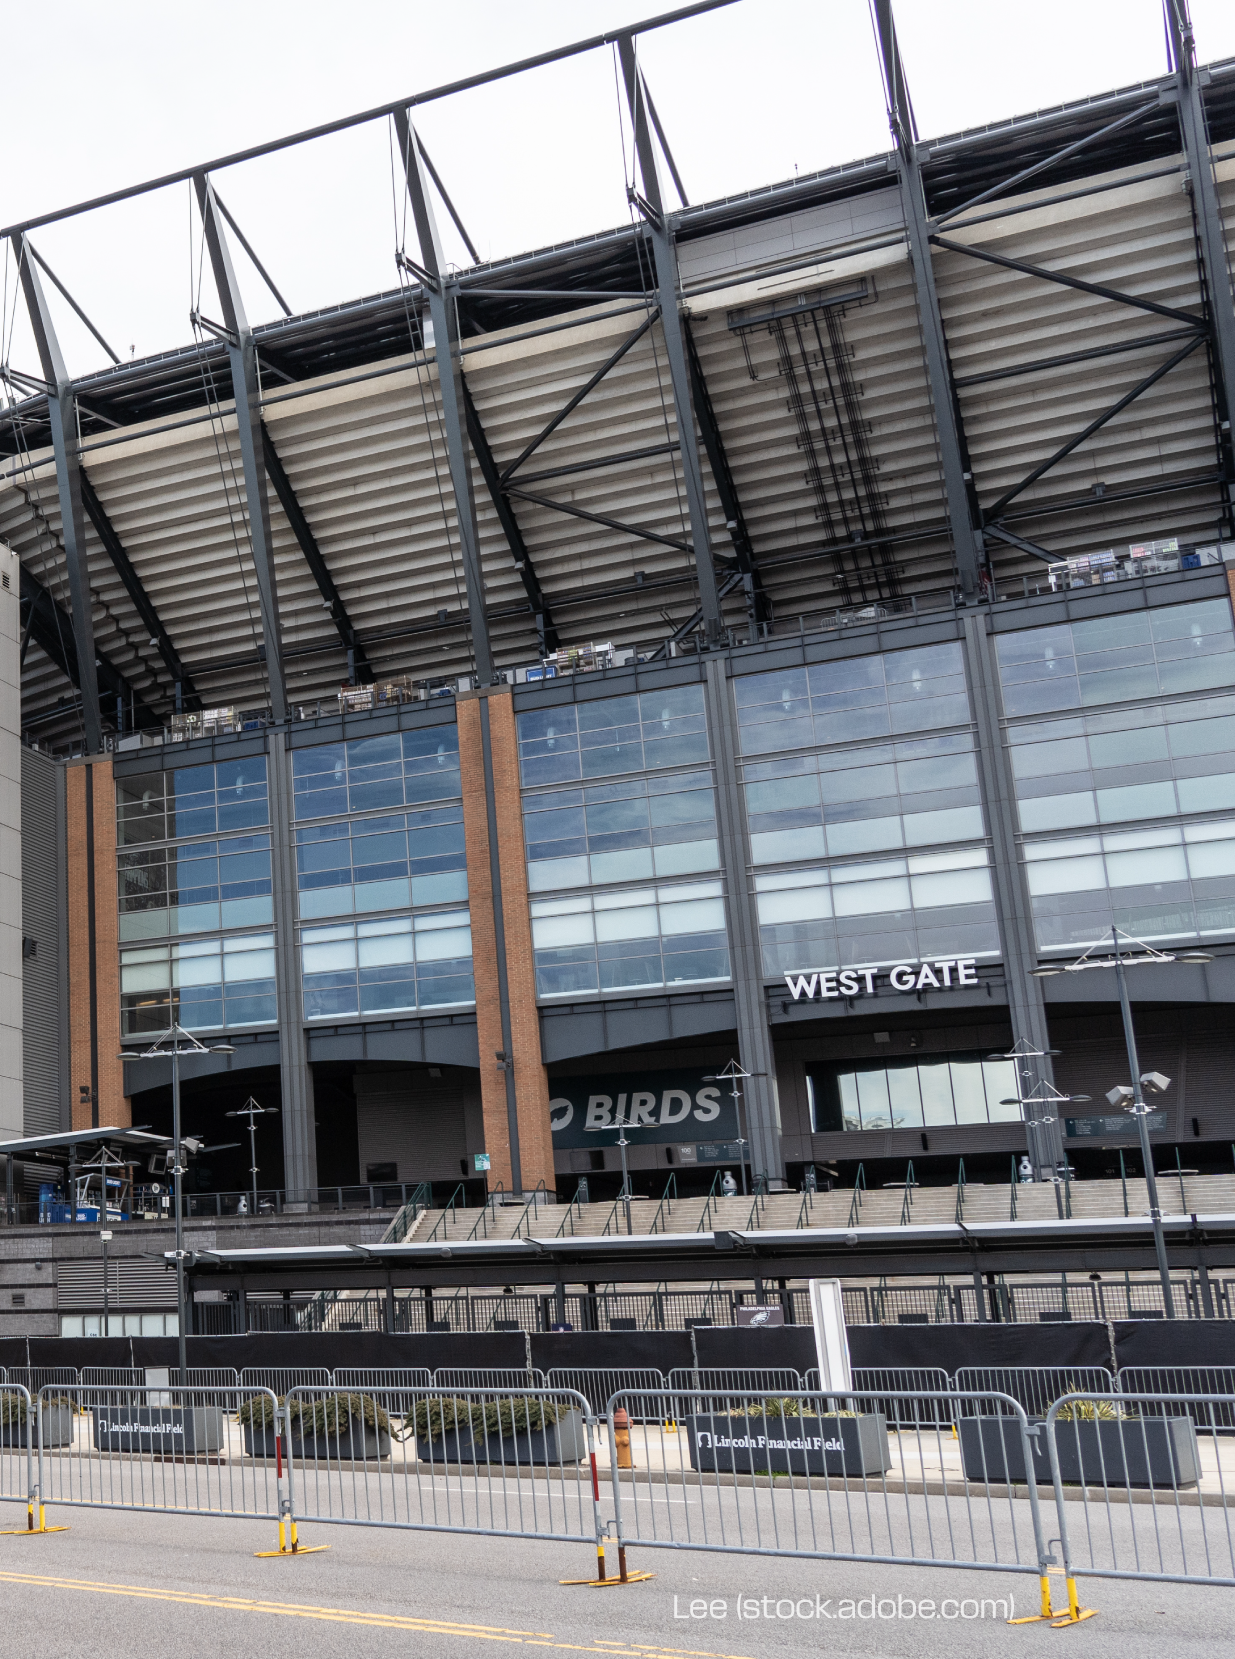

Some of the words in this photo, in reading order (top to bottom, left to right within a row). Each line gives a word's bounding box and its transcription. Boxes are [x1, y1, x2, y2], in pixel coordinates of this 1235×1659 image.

[784, 967, 878, 1000] WEST
[889, 958, 979, 991] GATE
[585, 1086, 722, 1129] BIRDS
[165, 1423, 184, 1434] Feld
[713, 1434, 757, 1448] Lincoln
[757, 1435, 813, 1450] Financial
